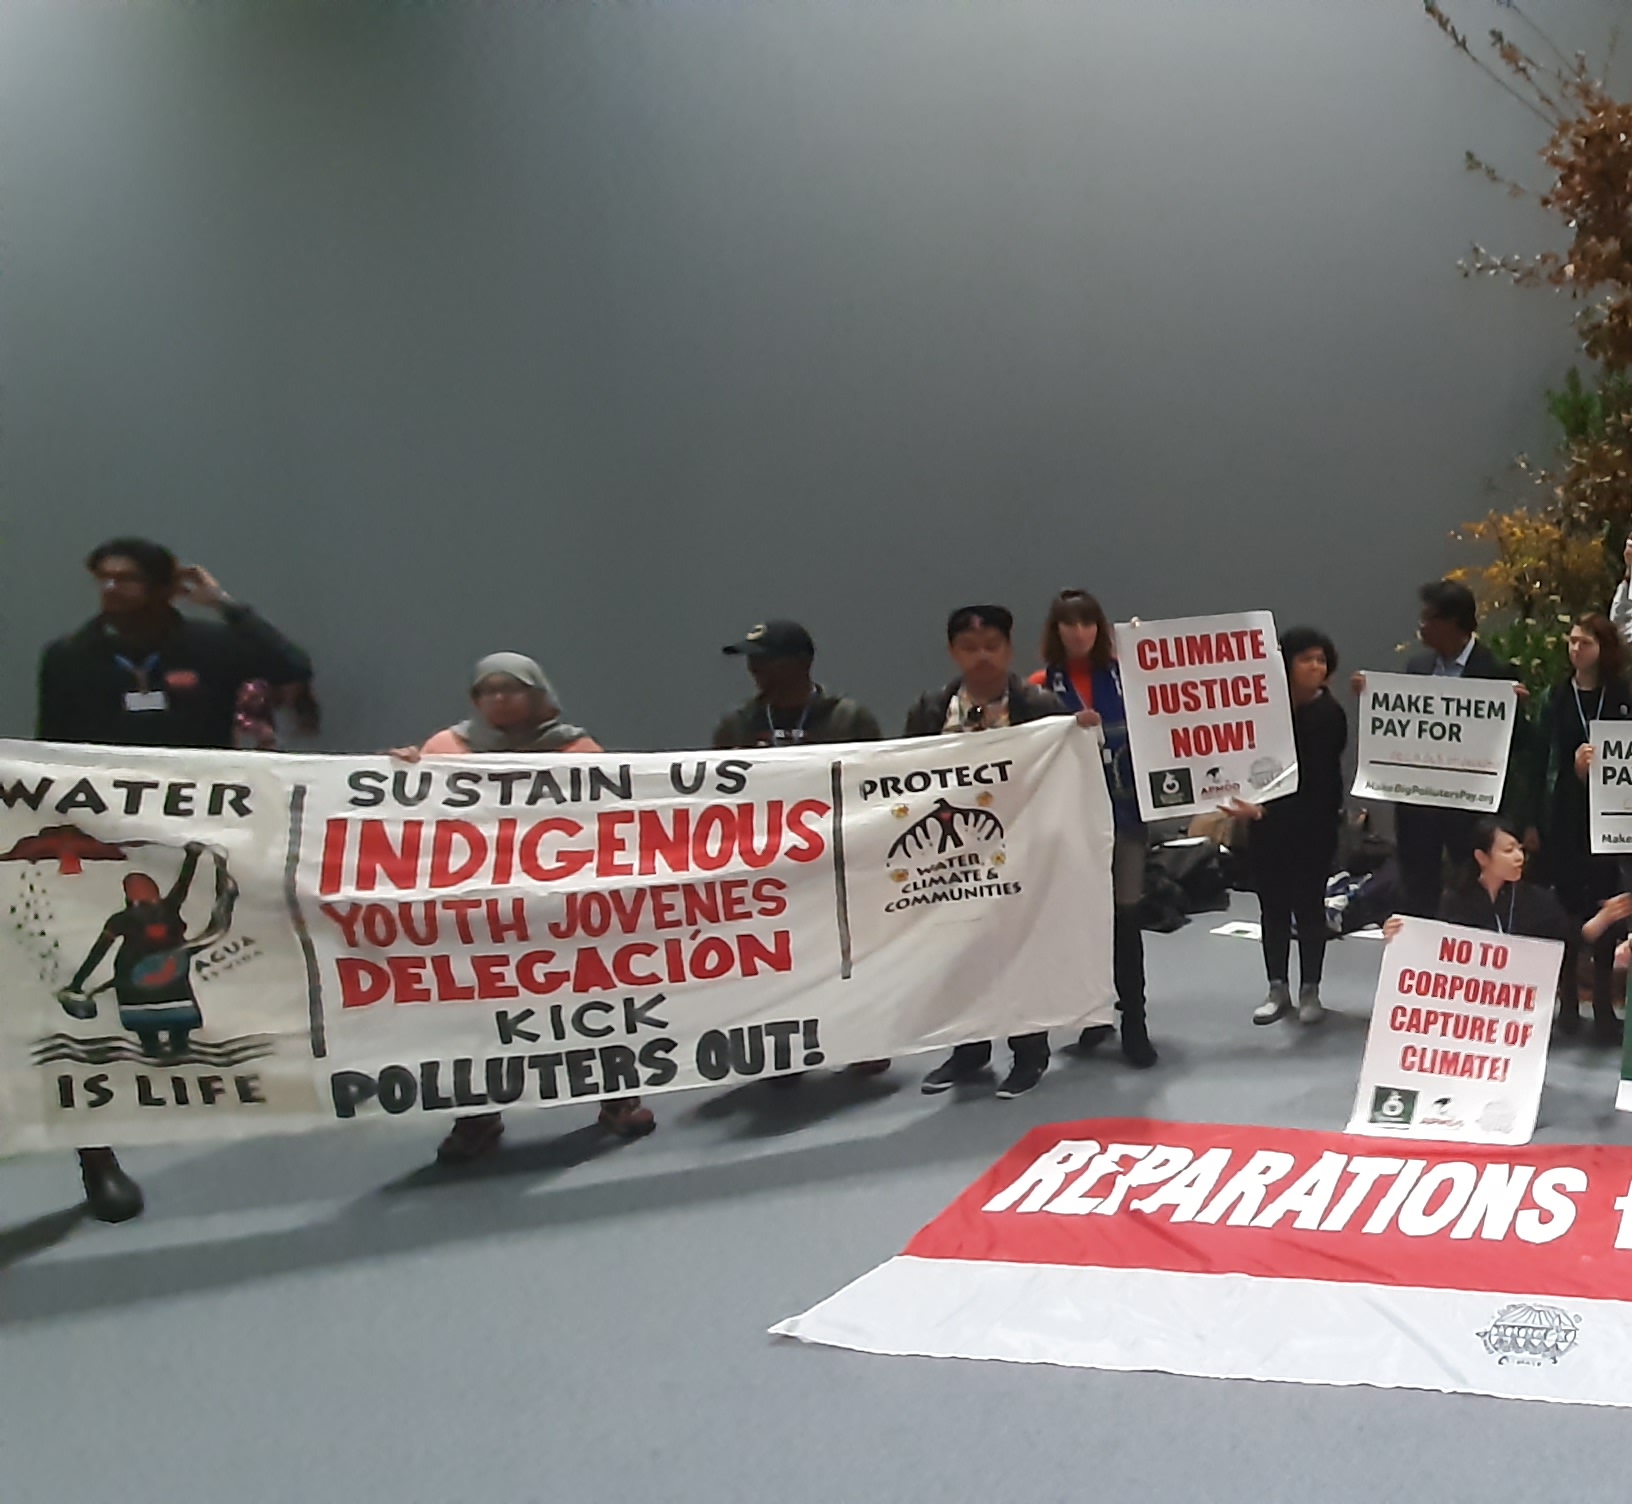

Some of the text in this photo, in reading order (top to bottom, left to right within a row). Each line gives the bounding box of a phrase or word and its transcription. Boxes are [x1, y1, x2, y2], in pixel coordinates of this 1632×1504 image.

[1136, 629, 1267, 671] CLIMATE
[1147, 674, 1269, 716] JUSTICE
[1371, 692, 1506, 721] MAKE THEM
[1170, 720, 1256, 758] NOW!
[1371, 717, 1462, 743] PAY FOR
[0, 776, 254, 818] WATER
[348, 759, 753, 807] SUSTAIN US
[860, 760, 1013, 801] PROTECT
[319, 799, 831, 895] INDIGENOUS
[884, 881, 1023, 913] COMMUNITIES
[901, 867, 999, 894] CLIMATE &
[321, 877, 788, 948] YOUTH JOVENES
[336, 928, 793, 1009] DELEGACIÓN
[1439, 937, 1509, 969] NO TO
[1398, 968, 1538, 1012] CORPORATE
[495, 993, 670, 1046] KICK
[1390, 1005, 1534, 1048] CAPTURE OF
[331, 1019, 826, 1118] POLLUTERS OUT!
[1400, 1045, 1511, 1083] CLIMATE!
[57, 1072, 267, 1110] IS LIFE
[982, 1138, 1588, 1244] REPARATIONS
